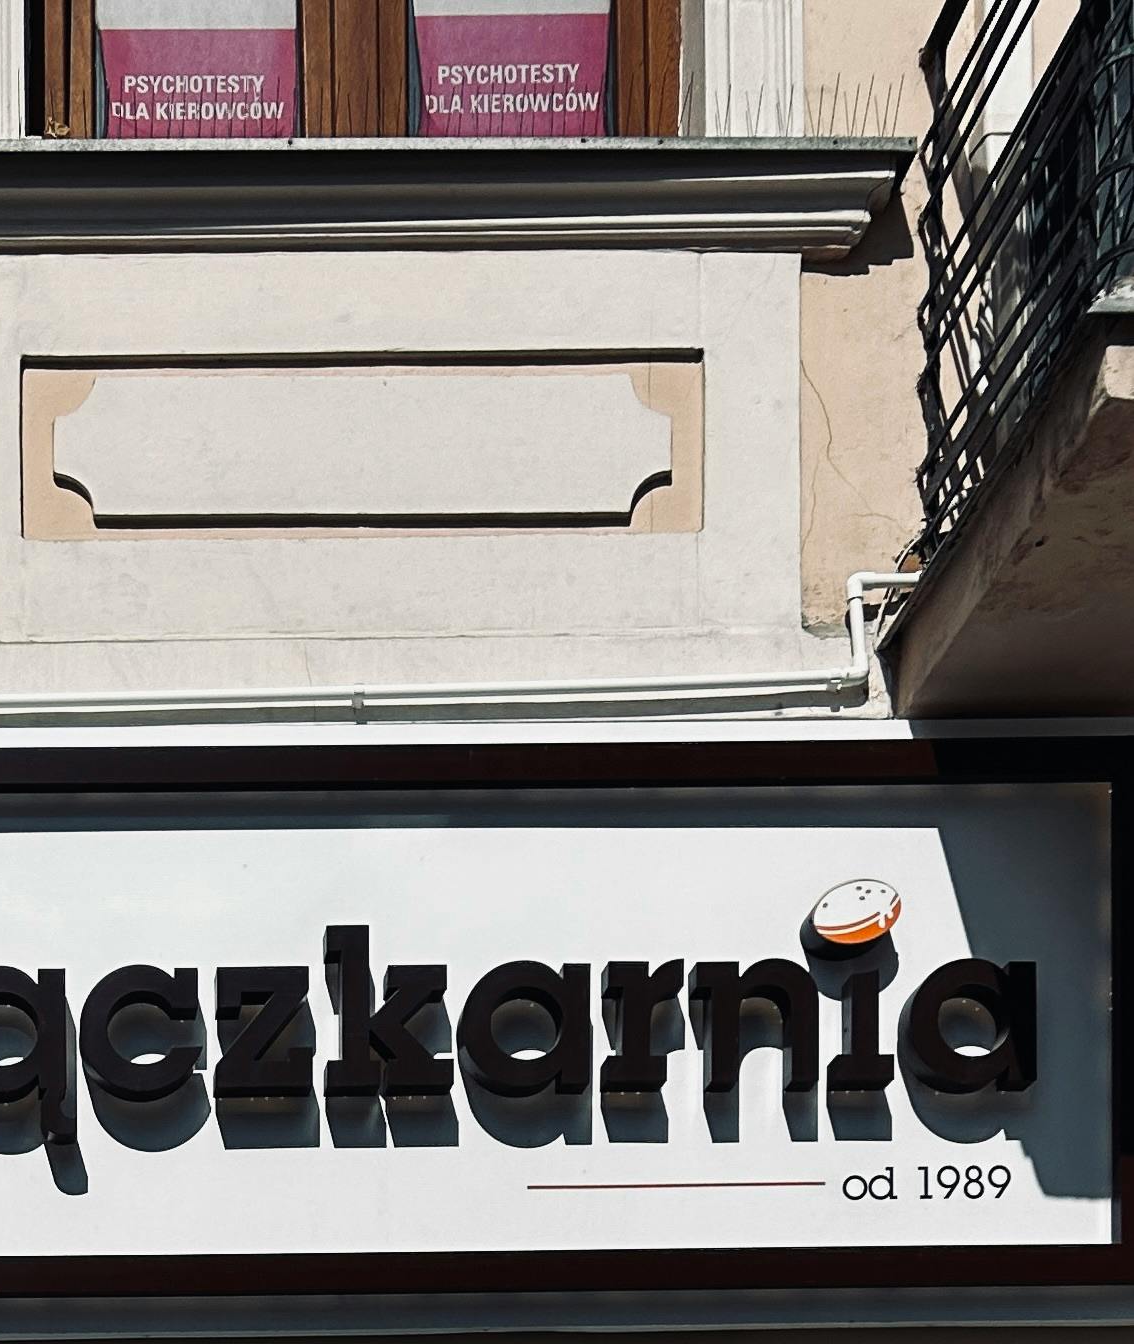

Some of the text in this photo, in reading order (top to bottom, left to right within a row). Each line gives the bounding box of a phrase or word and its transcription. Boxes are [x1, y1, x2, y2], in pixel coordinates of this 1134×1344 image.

[123, 74, 265, 95] PSYCHOTESTY
[437, 64, 579, 85] PSYCHOTESTY
[111, 96, 284, 121] DLA KIEROWCÓW
[425, 86, 599, 114] DLA KIEROWCÓW
[841, 1164, 1013, 1201] od 1989
